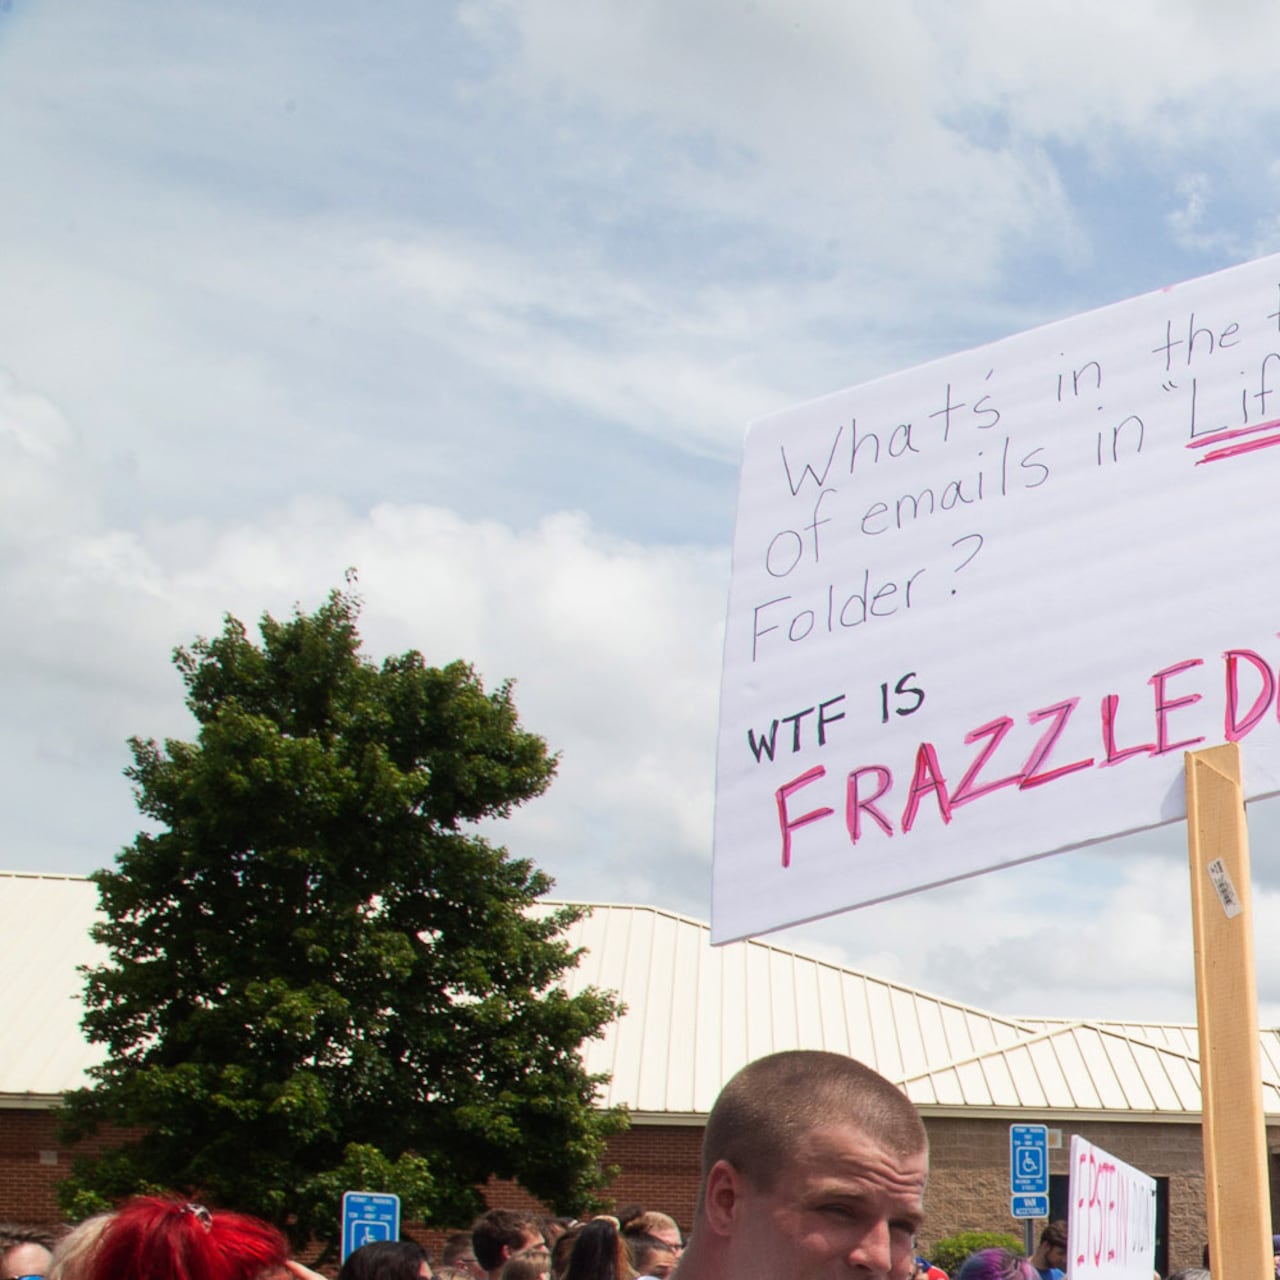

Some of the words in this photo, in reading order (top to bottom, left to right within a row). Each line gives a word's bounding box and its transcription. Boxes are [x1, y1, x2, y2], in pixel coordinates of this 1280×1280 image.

[781, 364, 1001, 499] What's
[1056, 354, 1103, 403] in
[1153, 316, 1241, 373] the
[860, 440, 1050, 539] emails
[1095, 405, 1146, 465] in
[751, 533, 985, 663] Folder?
[748, 692, 848, 764] WTF
[880, 672, 926, 725] IS
[1076, 1150, 1130, 1268] EPSTEIN
